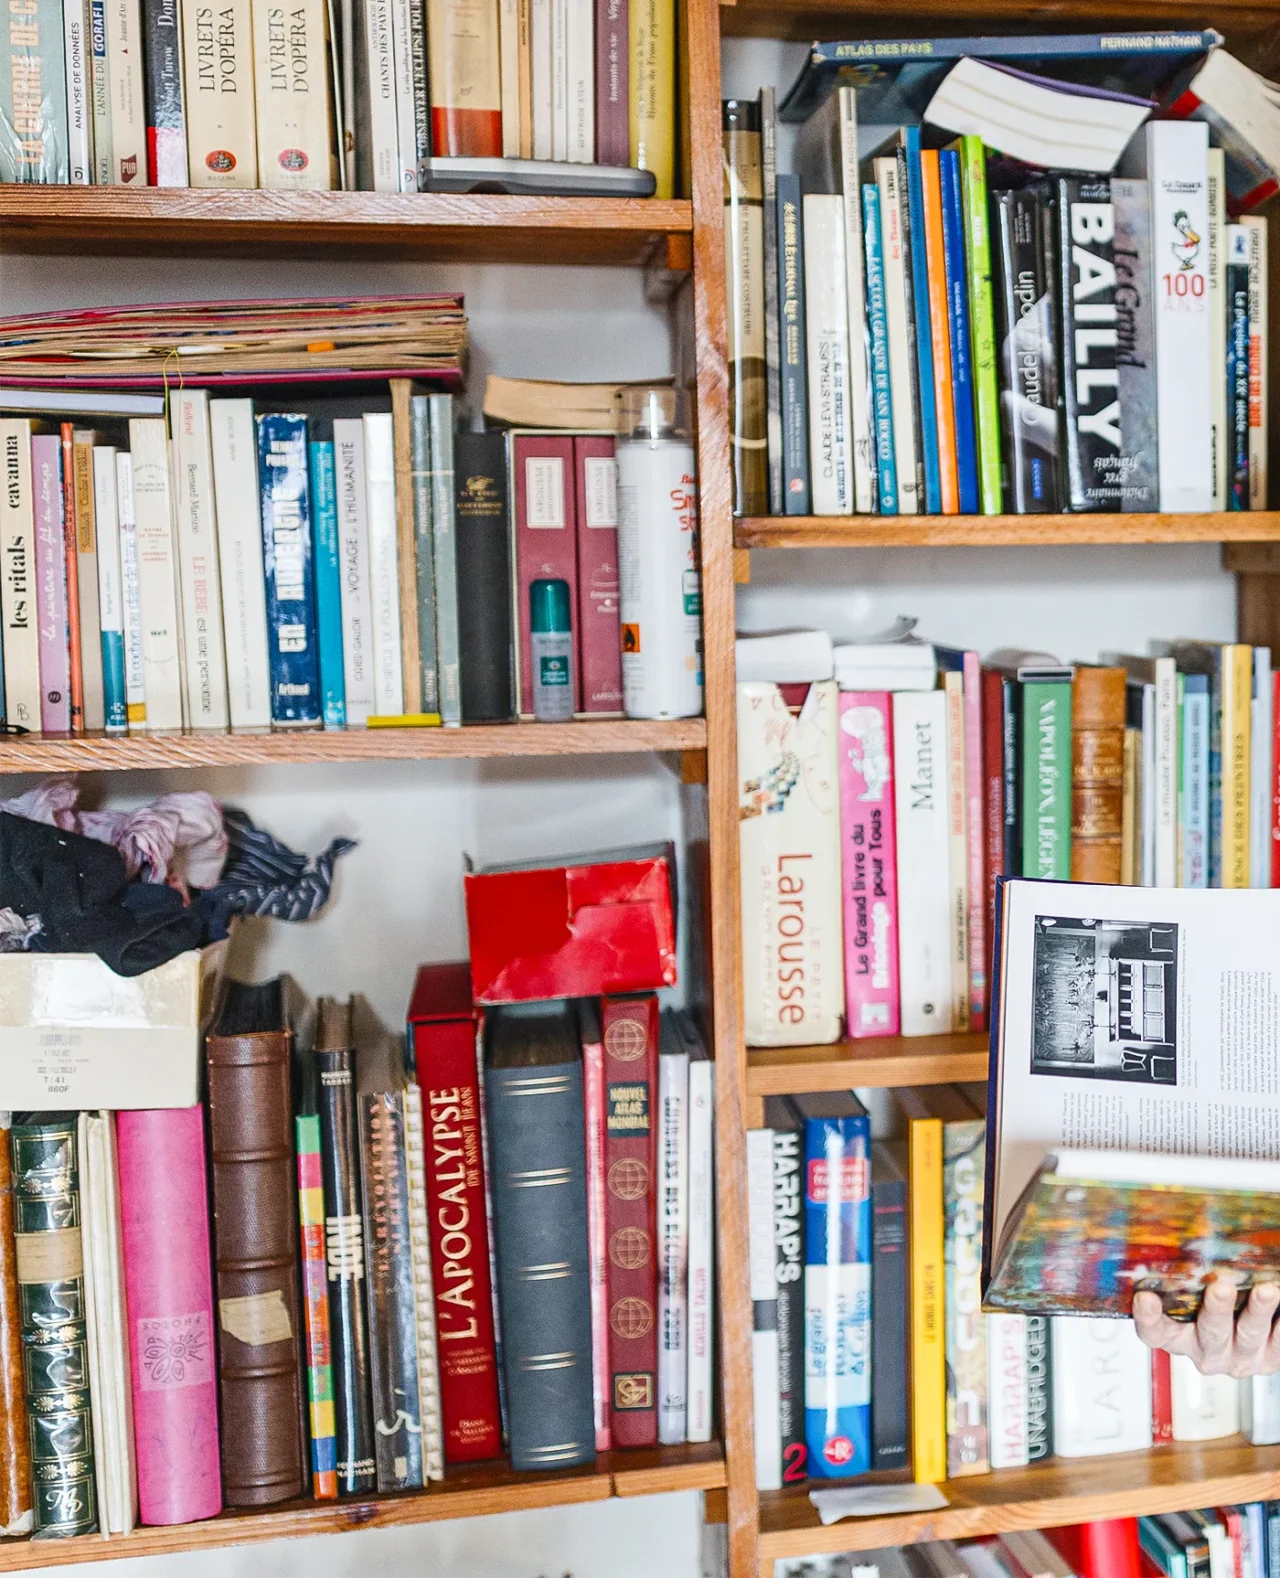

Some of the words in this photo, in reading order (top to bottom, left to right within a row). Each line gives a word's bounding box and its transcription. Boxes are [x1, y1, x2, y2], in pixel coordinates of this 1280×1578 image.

[9, 20, 39, 47] DE
[93, 7, 104, 52] GORAFI
[378, 6, 388, 31] PAYS
[69, 22, 80, 69] DONNÉES
[197, 8, 215, 92] LIVRETS
[220, 7, 236, 94] D'OPÉRA
[268, 8, 287, 92] LIVRETS
[291, 7, 309, 94] D'OPÉRA
[379, 33, 388, 54] DES
[609, 48, 617, 63] de
[835, 44, 873, 57] ATLAS
[876, 43, 899, 56] DES
[901, 42, 932, 55] PAYS
[1101, 36, 1152, 48] FERNAND
[1154, 34, 1202, 47] NATHAN
[73, 70, 81, 84] DE
[95, 58, 104, 74] DU
[161, 46, 173, 81] Turow
[379, 56, 390, 99] CHANTS
[73, 86, 82, 130] ANALYSE
[93, 77, 105, 116] L'ANNÉE
[161, 83, 174, 110] Scott
[413, 90, 427, 149] OBSERVER
[121, 161, 137, 175] PUR
[785, 246, 797, 298] ETERNAL
[870, 256, 881, 274] LA
[871, 275, 884, 319] SCUOLA
[1014, 270, 1035, 330] Rodin
[1162, 274, 1205, 297] 100
[873, 320, 886, 365] GRANDE
[1071, 202, 1122, 449] BAILLY
[1234, 308, 1247, 358] physique
[876, 367, 887, 380] DE
[1235, 360, 1247, 375] du
[877, 381, 889, 410] SAN
[878, 412, 891, 460] ROCCO
[1236, 399, 1248, 433] siècle
[7, 435, 20, 509] cavanna
[821, 431, 833, 479] CLAUDE
[1093, 454, 1140, 472] français
[187, 463, 199, 499] Bernard
[338, 441, 357, 524] L'HUMANITÉ
[1085, 485, 1149, 501] Dictionnaire
[1103, 471, 1130, 485] grec
[7, 535, 27, 593] ritals
[192, 556, 205, 573] LE
[346, 538, 360, 594] VOYAGE
[9, 601, 28, 629] les
[196, 636, 211, 658] une
[196, 660, 213, 714] personne
[912, 721, 933, 812] Manet
[1038, 698, 1060, 813] NAPOLÉON
[851, 824, 865, 845] du
[867, 808, 883, 849] Tous
[852, 851, 867, 891] livre
[869, 856, 886, 897] pour
[777, 852, 813, 1026] Larousse
[853, 895, 868, 948] Grand
[855, 954, 869, 975] Le
[460, 1086, 476, 1120] JEAN
[610, 1086, 647, 1101] NOUVEL
[614, 1101, 643, 1115] ATLAS
[607, 1115, 650, 1129] MONDIAL
[463, 1124, 479, 1162] SAINT
[430, 1086, 479, 1341] L'APOCALYPSE
[773, 1133, 800, 1285] HARRAP'S
[326, 1213, 364, 1282] INDE
[999, 1318, 1024, 1460] HARRAP'S
[1026, 1317, 1048, 1459] UNABRIDGED
[783, 1442, 807, 1482] 2
